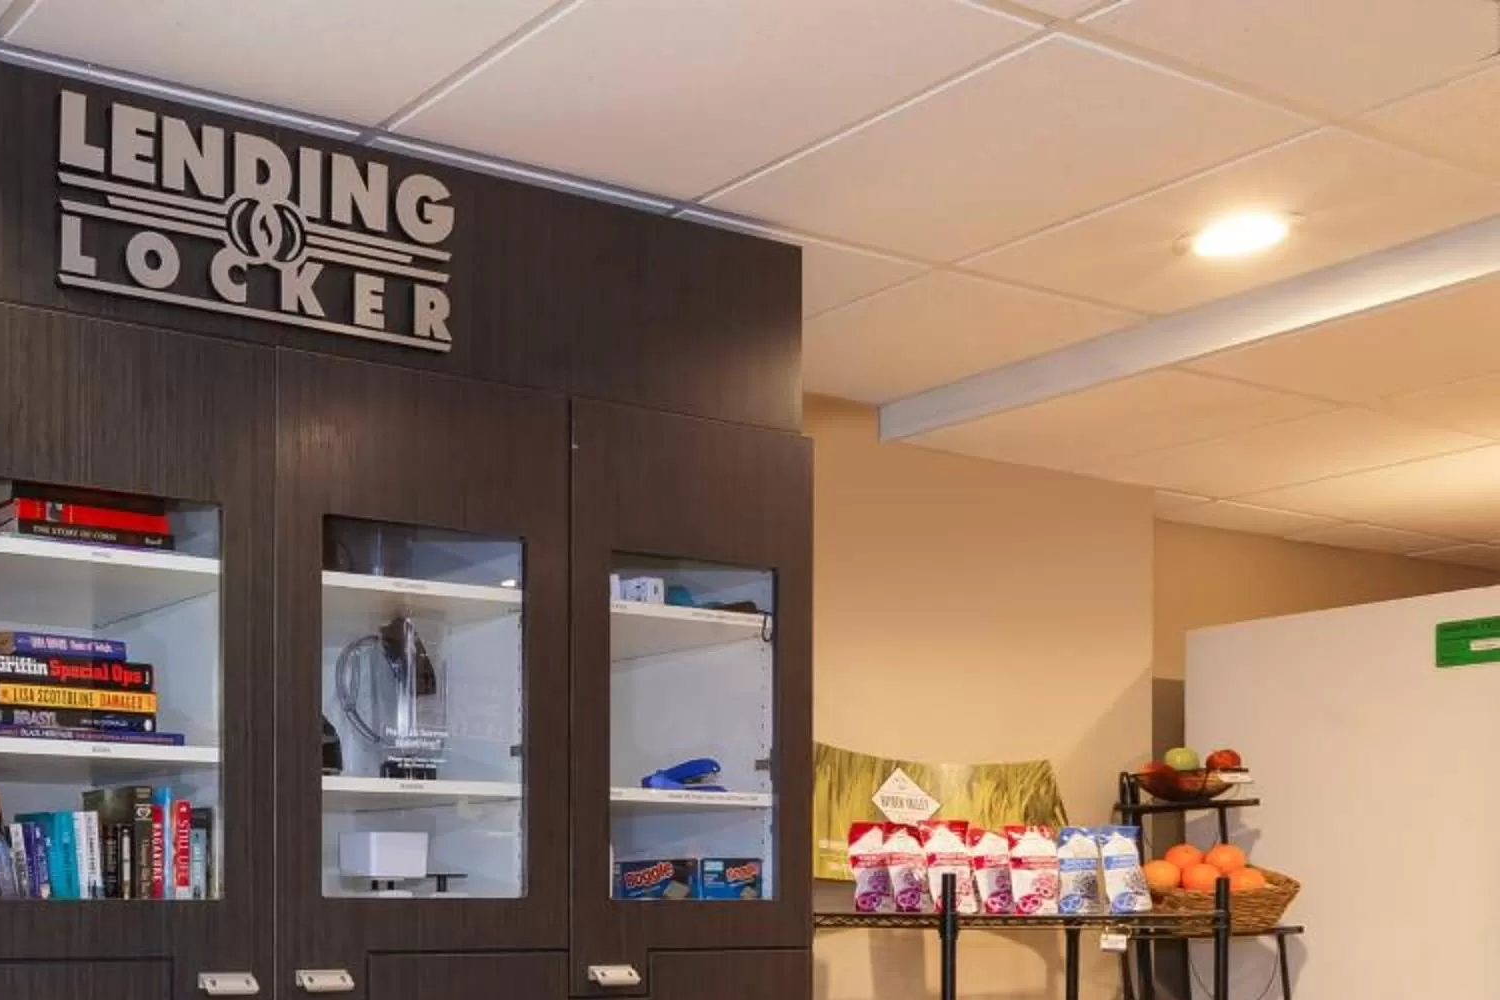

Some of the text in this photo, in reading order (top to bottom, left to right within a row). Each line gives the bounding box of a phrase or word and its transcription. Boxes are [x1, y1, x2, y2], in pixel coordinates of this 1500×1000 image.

[59, 88, 456, 244] LENDING
[60, 213, 453, 341] LOCKER
[50, 658, 109, 684] Special
[111, 665, 143, 687] Ops
[13, 687, 35, 702] LISA
[100, 693, 143, 710] DAMAGED
[177, 819, 189, 849] STILL
